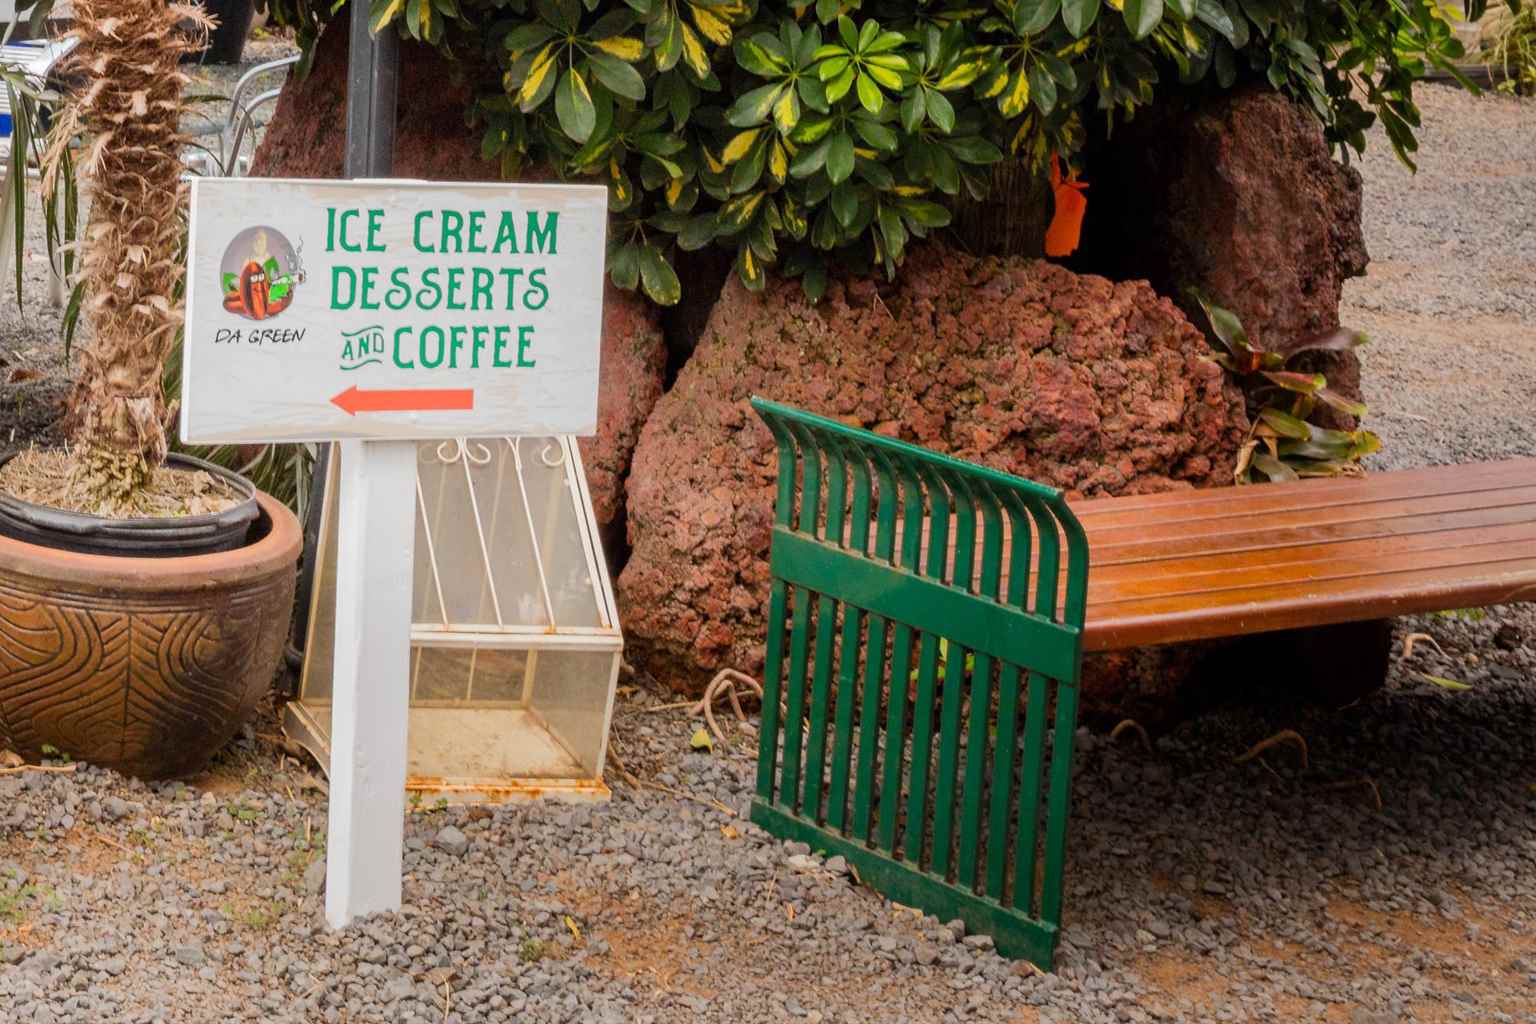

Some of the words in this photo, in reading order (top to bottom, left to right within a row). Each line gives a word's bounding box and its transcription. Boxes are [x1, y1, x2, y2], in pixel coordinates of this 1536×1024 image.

[325, 207, 386, 253] ICE
[413, 209, 559, 254] CREAM
[330, 265, 550, 311] DESSERTS
[214, 328, 242, 345] DA
[248, 327, 306, 345] GREEN
[340, 327, 384, 363] AND
[392, 325, 536, 369] COFFEE
